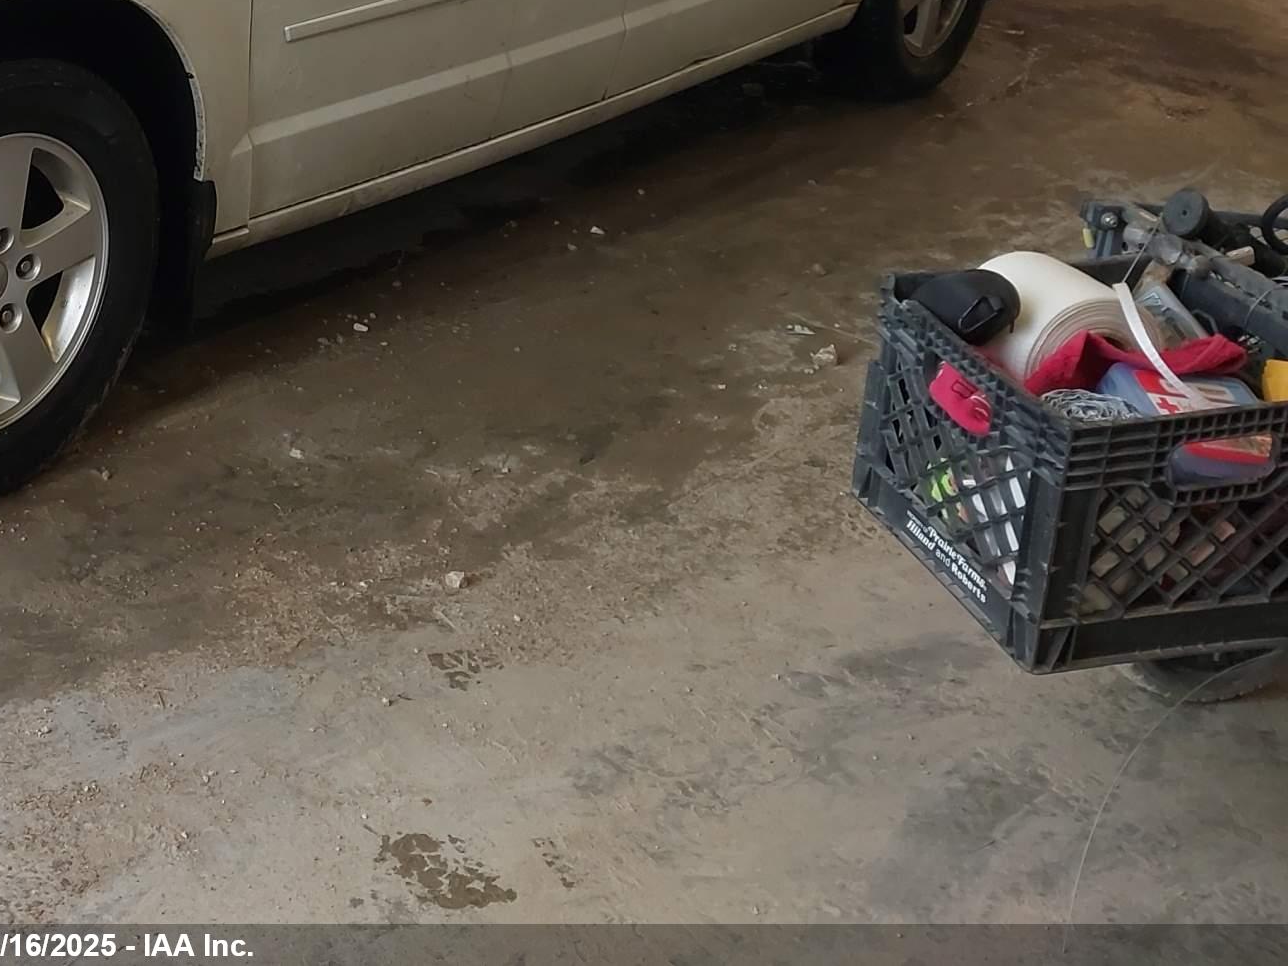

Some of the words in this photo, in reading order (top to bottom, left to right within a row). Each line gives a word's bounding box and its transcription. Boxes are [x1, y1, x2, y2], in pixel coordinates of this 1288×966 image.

[927, 525, 958, 560] Prairie
[935, 548, 952, 567] and
[951, 562, 987, 603] Roberts
